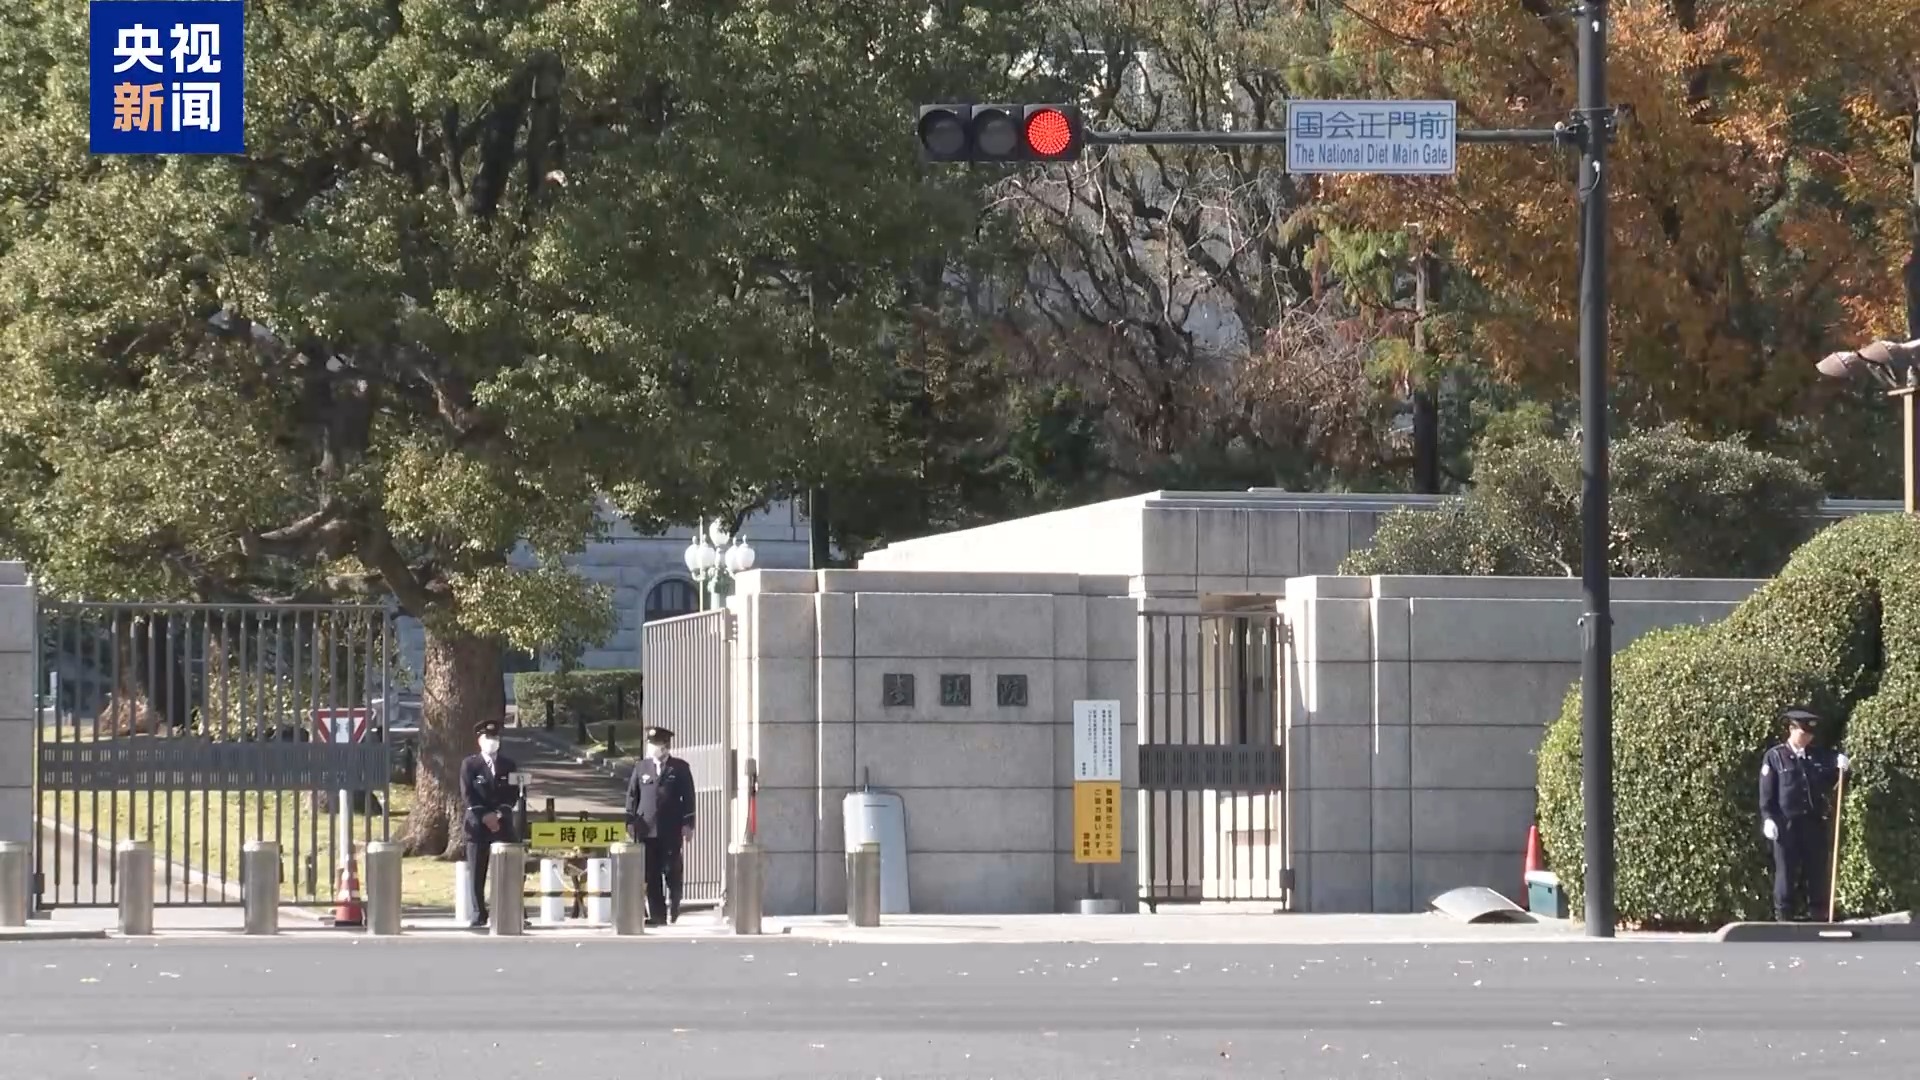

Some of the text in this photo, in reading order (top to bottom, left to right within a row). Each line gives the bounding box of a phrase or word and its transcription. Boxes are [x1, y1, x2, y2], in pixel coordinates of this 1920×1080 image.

[1295, 110, 1449, 140] 国会正門前
[1295, 143, 1448, 165] The National Diet Main Gate
[538, 825, 620, 843] 一時停止
